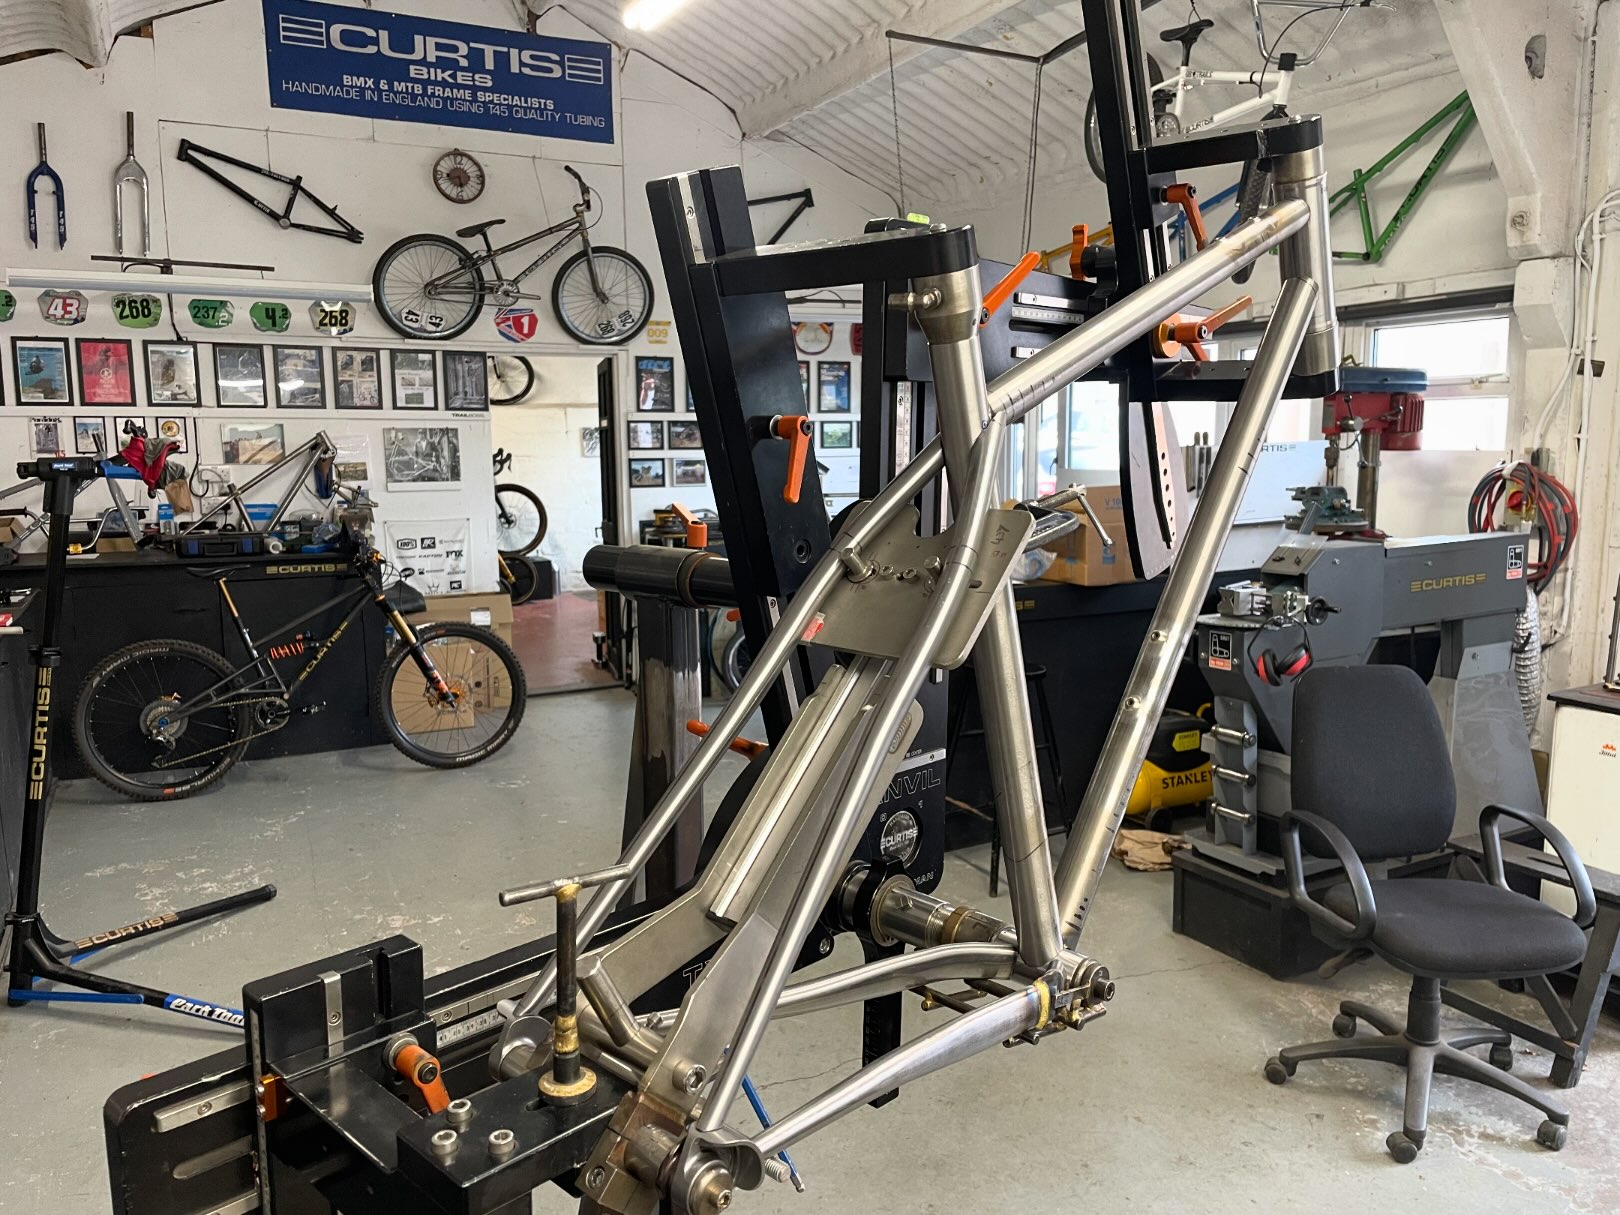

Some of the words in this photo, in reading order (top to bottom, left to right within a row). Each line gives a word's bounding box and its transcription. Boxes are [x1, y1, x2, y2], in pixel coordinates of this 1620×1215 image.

[329, 23, 563, 78] CURTIS
[409, 64, 493, 87] BIKES
[343, 75, 374, 89] BMX
[379, 79, 388, 90] &
[394, 81, 422, 94] MTB
[427, 85, 472, 100] FRAME
[477, 91, 554, 110] SPECIALISTS
[282, 80, 360, 100] HANDMADE
[365, 90, 377, 101] IN
[382, 91, 443, 108] ENGLAND
[447, 102, 484, 113] USING
[488, 104, 508, 116] T45
[512, 107, 561, 123] QUALITY
[565, 113, 605, 127] TUBING
[48, 297, 80, 319] 43
[116, 298, 152, 320] 268
[192, 305, 218, 319] 237
[318, 309, 350, 327] 268
[404, 309, 420, 323] 43
[618, 310, 635, 327] 268
[428, 315, 444, 329] 43
[520, 315, 530, 334] 1
[597, 320, 615, 335] 268
[1260, 444, 1288, 453] RTIS
[278, 563, 336, 574] CURTIS
[1422, 574, 1476, 591] CURTIS
[305, 630, 342, 672] CURTIS
[31, 687, 51, 781] CURTIS
[879, 768, 941, 805] NVIL
[885, 828, 913, 848] CURTIS
[93, 917, 165, 945] CURTIS
[170, 998, 212, 1018] Park
[212, 1007, 245, 1027] Too
